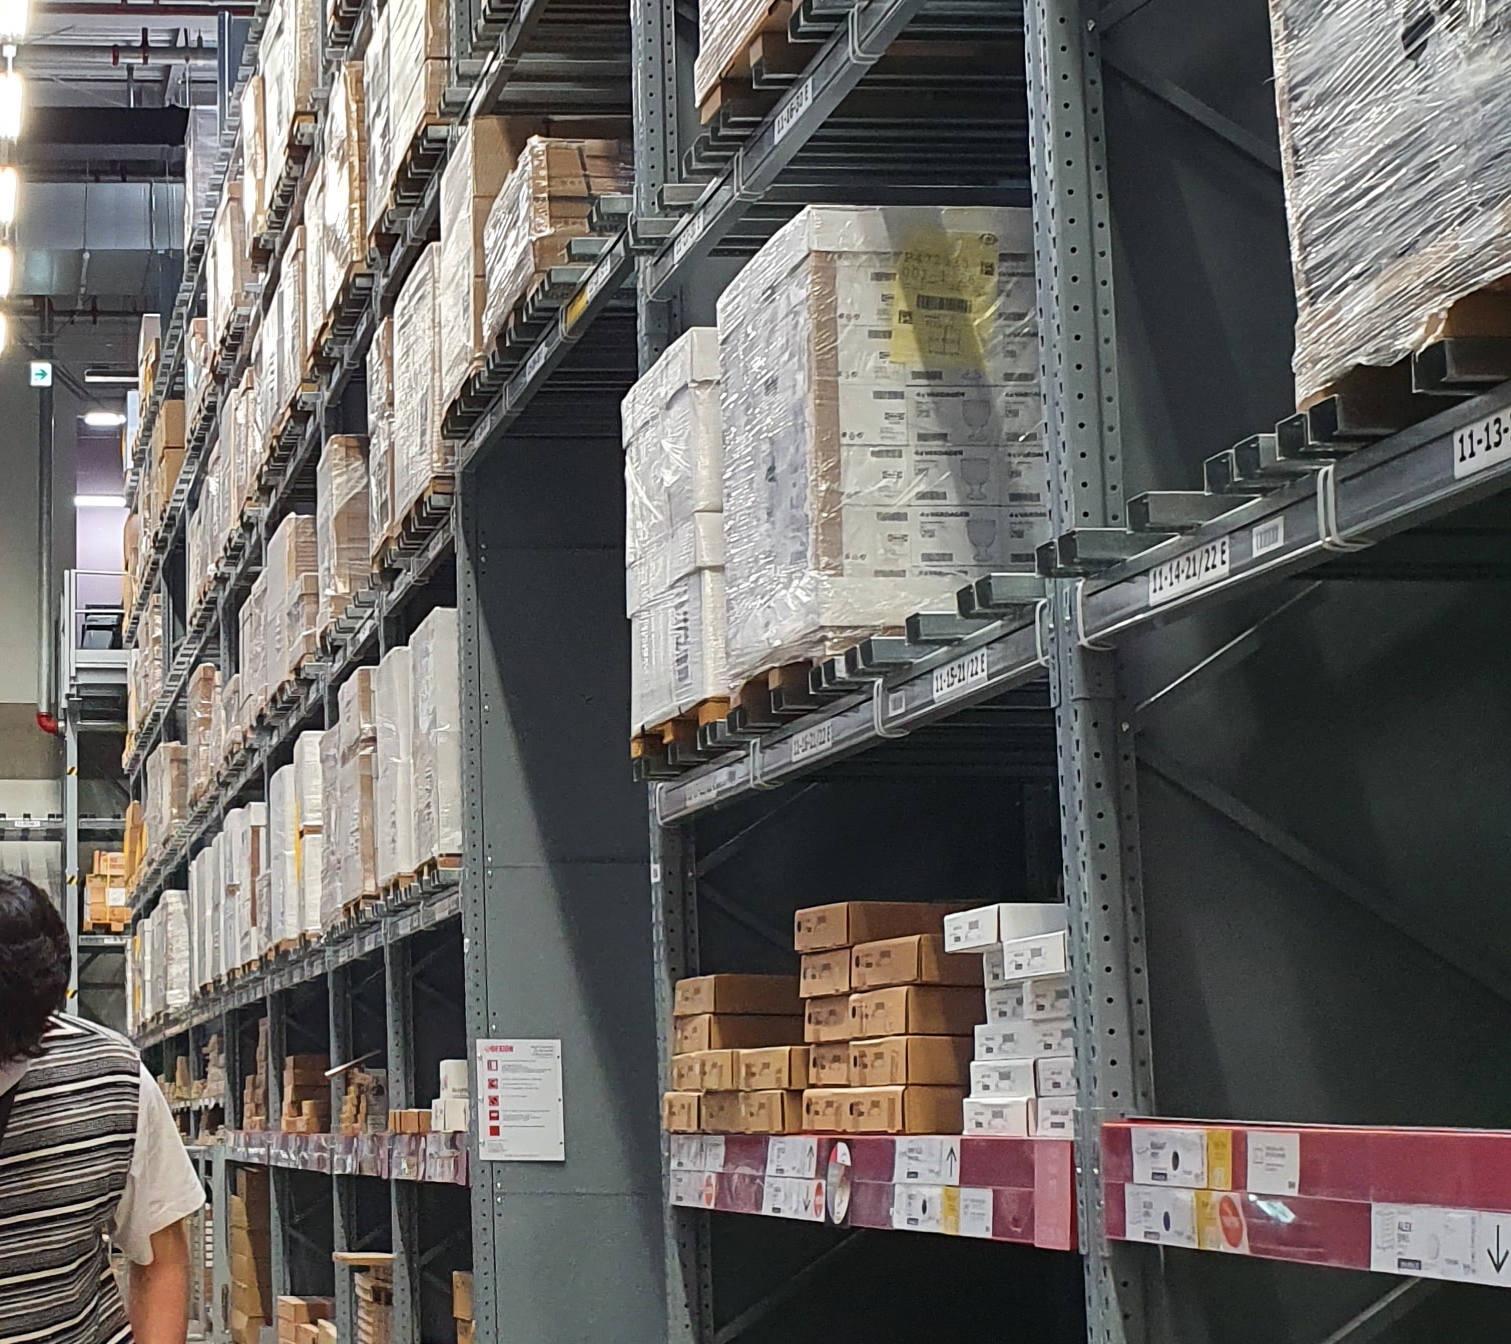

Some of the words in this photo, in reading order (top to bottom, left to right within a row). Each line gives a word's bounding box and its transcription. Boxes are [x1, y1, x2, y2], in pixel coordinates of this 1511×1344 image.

[1152, 548, 1217, 595] 11-14-21/22
[1220, 540, 1227, 567] E
[935, 657, 980, 694] 11-15-21/22
[980, 652, 987, 674] E
